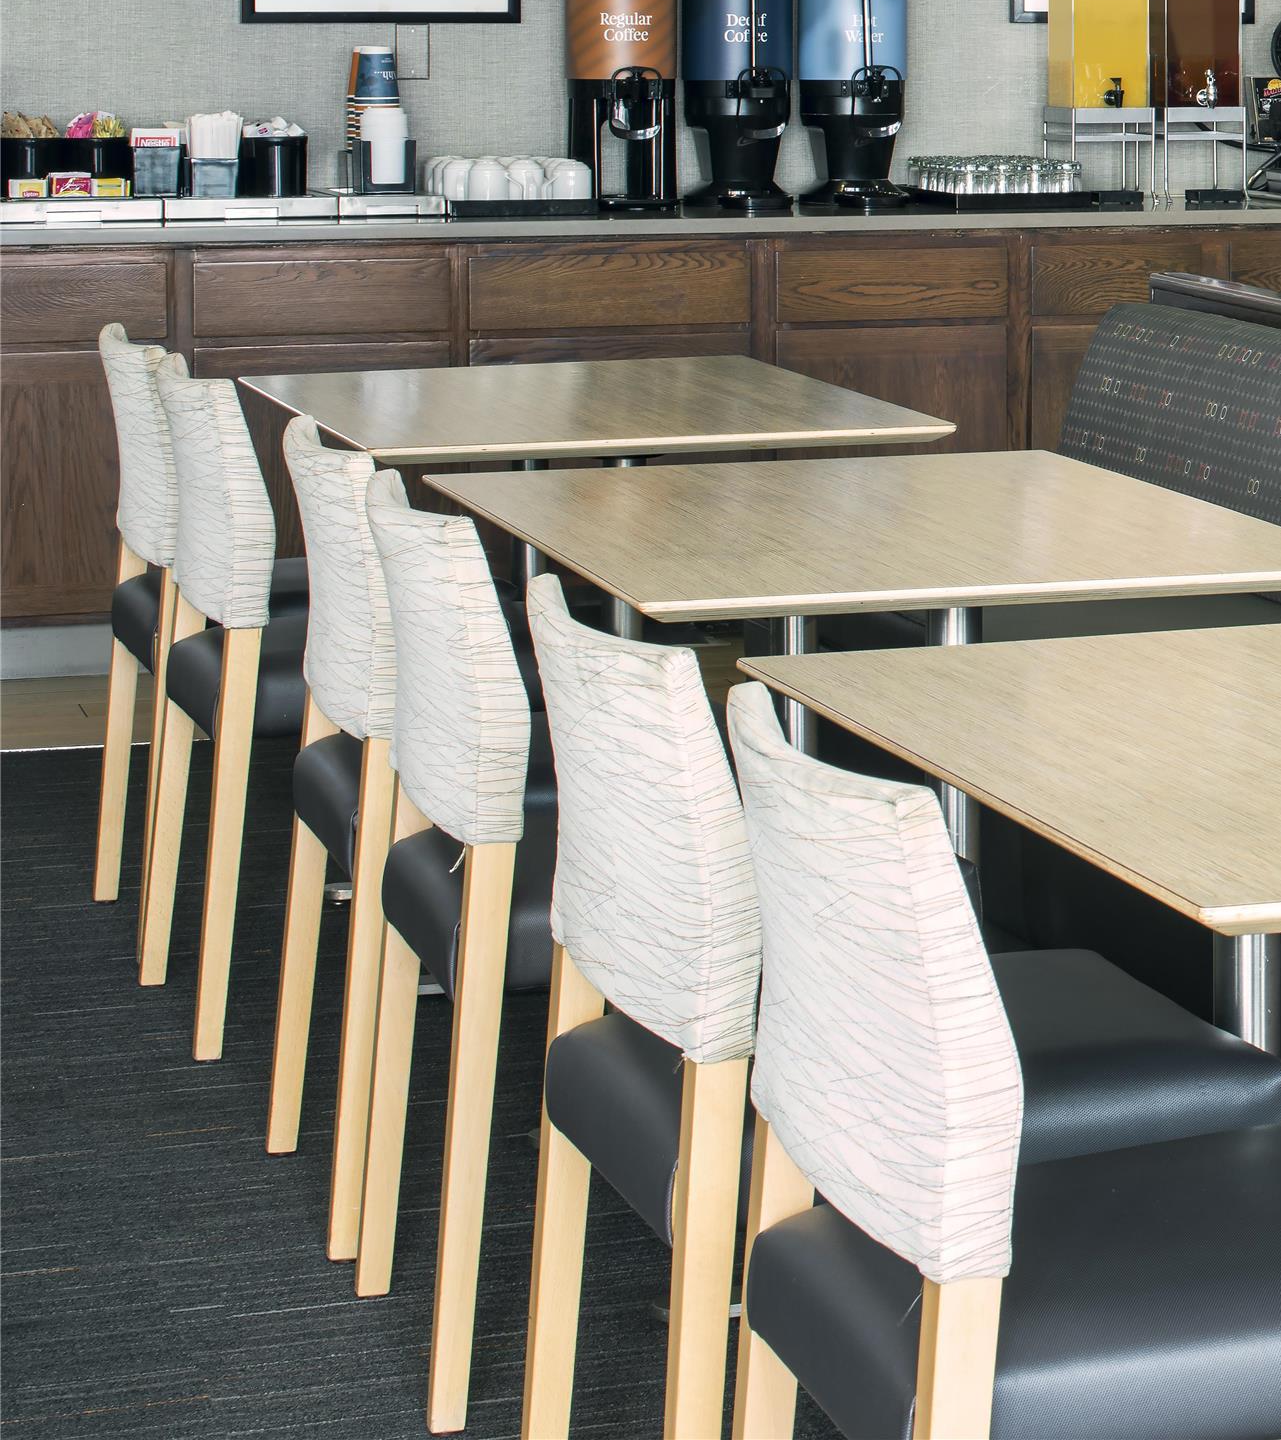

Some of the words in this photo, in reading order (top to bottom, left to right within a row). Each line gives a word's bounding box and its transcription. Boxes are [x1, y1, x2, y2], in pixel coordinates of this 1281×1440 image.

[600, 12, 652, 28] Regular
[852, 14, 877, 27] Ht
[604, 28, 648, 42] Coffee
[845, 29, 884, 43] Waer
